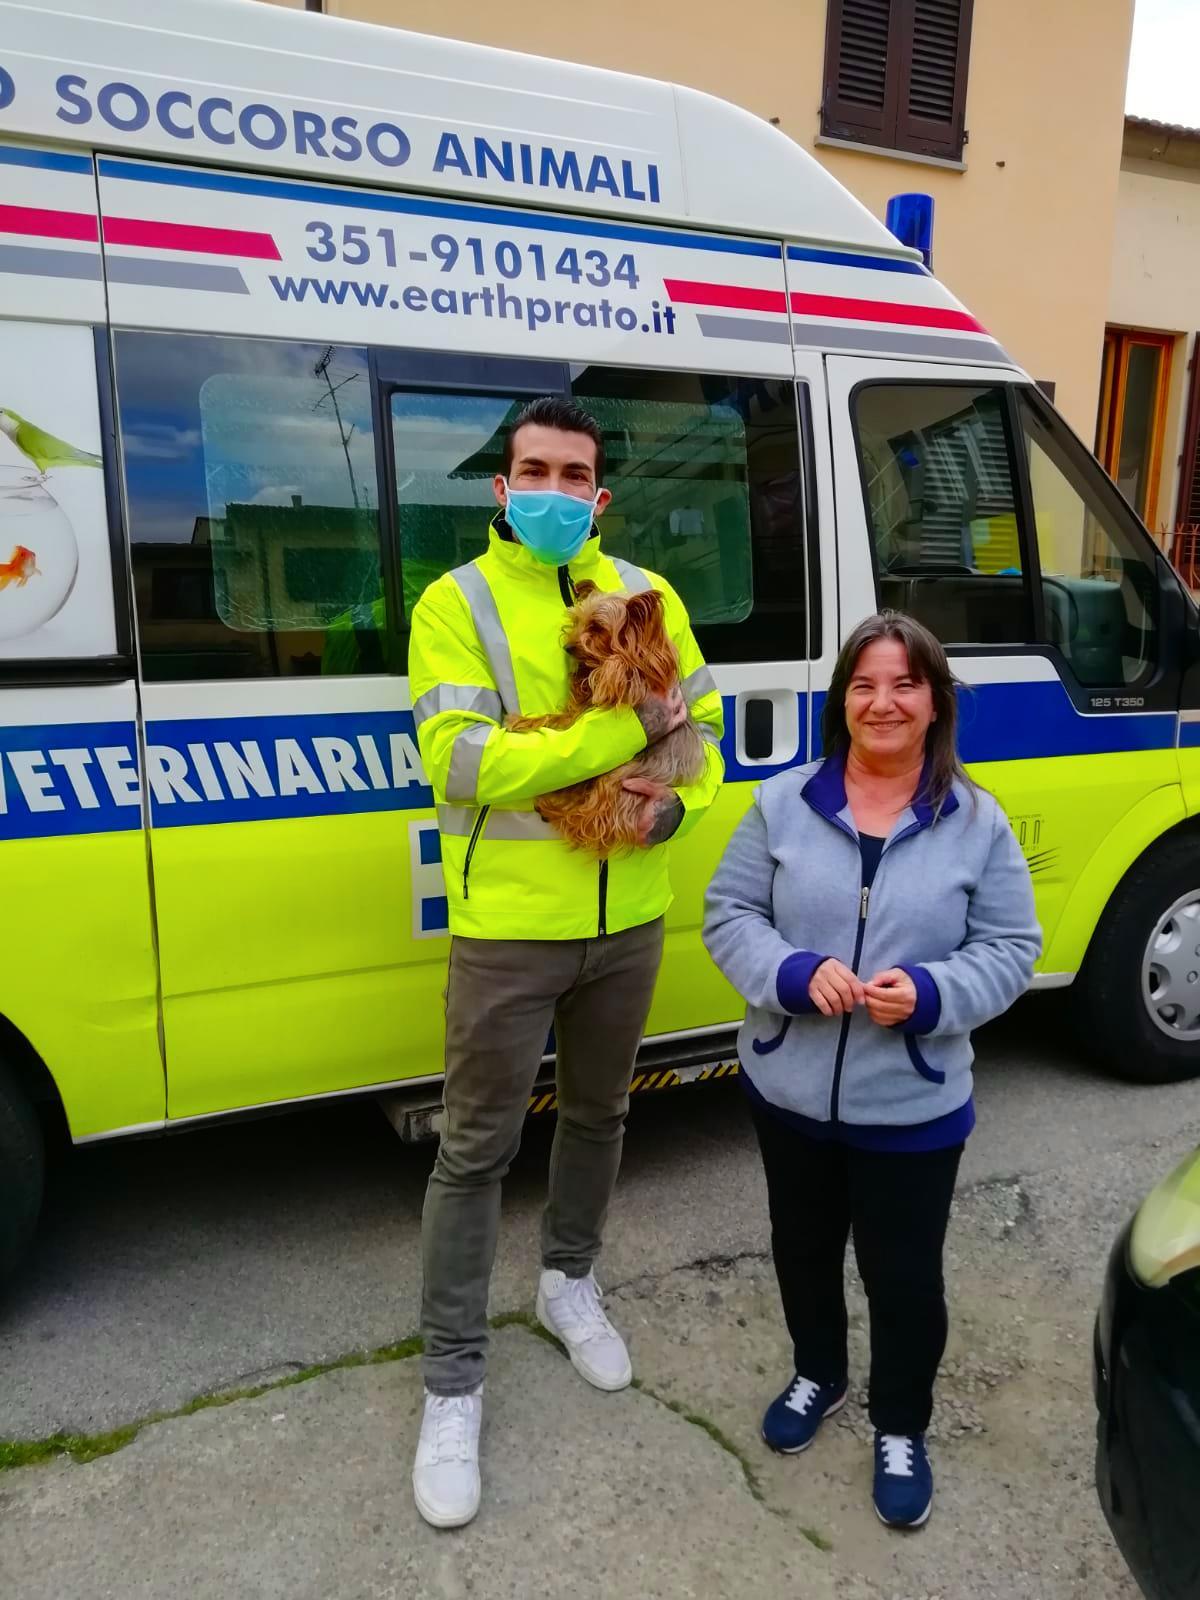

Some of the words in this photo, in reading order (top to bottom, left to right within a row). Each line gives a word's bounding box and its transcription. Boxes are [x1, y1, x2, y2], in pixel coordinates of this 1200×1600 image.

[55, 74, 411, 167] SOCCORSO
[432, 131, 661, 203] ANIMALI
[305, 221, 640, 290] 351-9101434
[268, 274, 677, 335] www.earthprato.it
[1090, 697, 1112, 707] 125
[1114, 697, 1145, 707] T350
[0, 733, 430, 814] ETERINARIA
